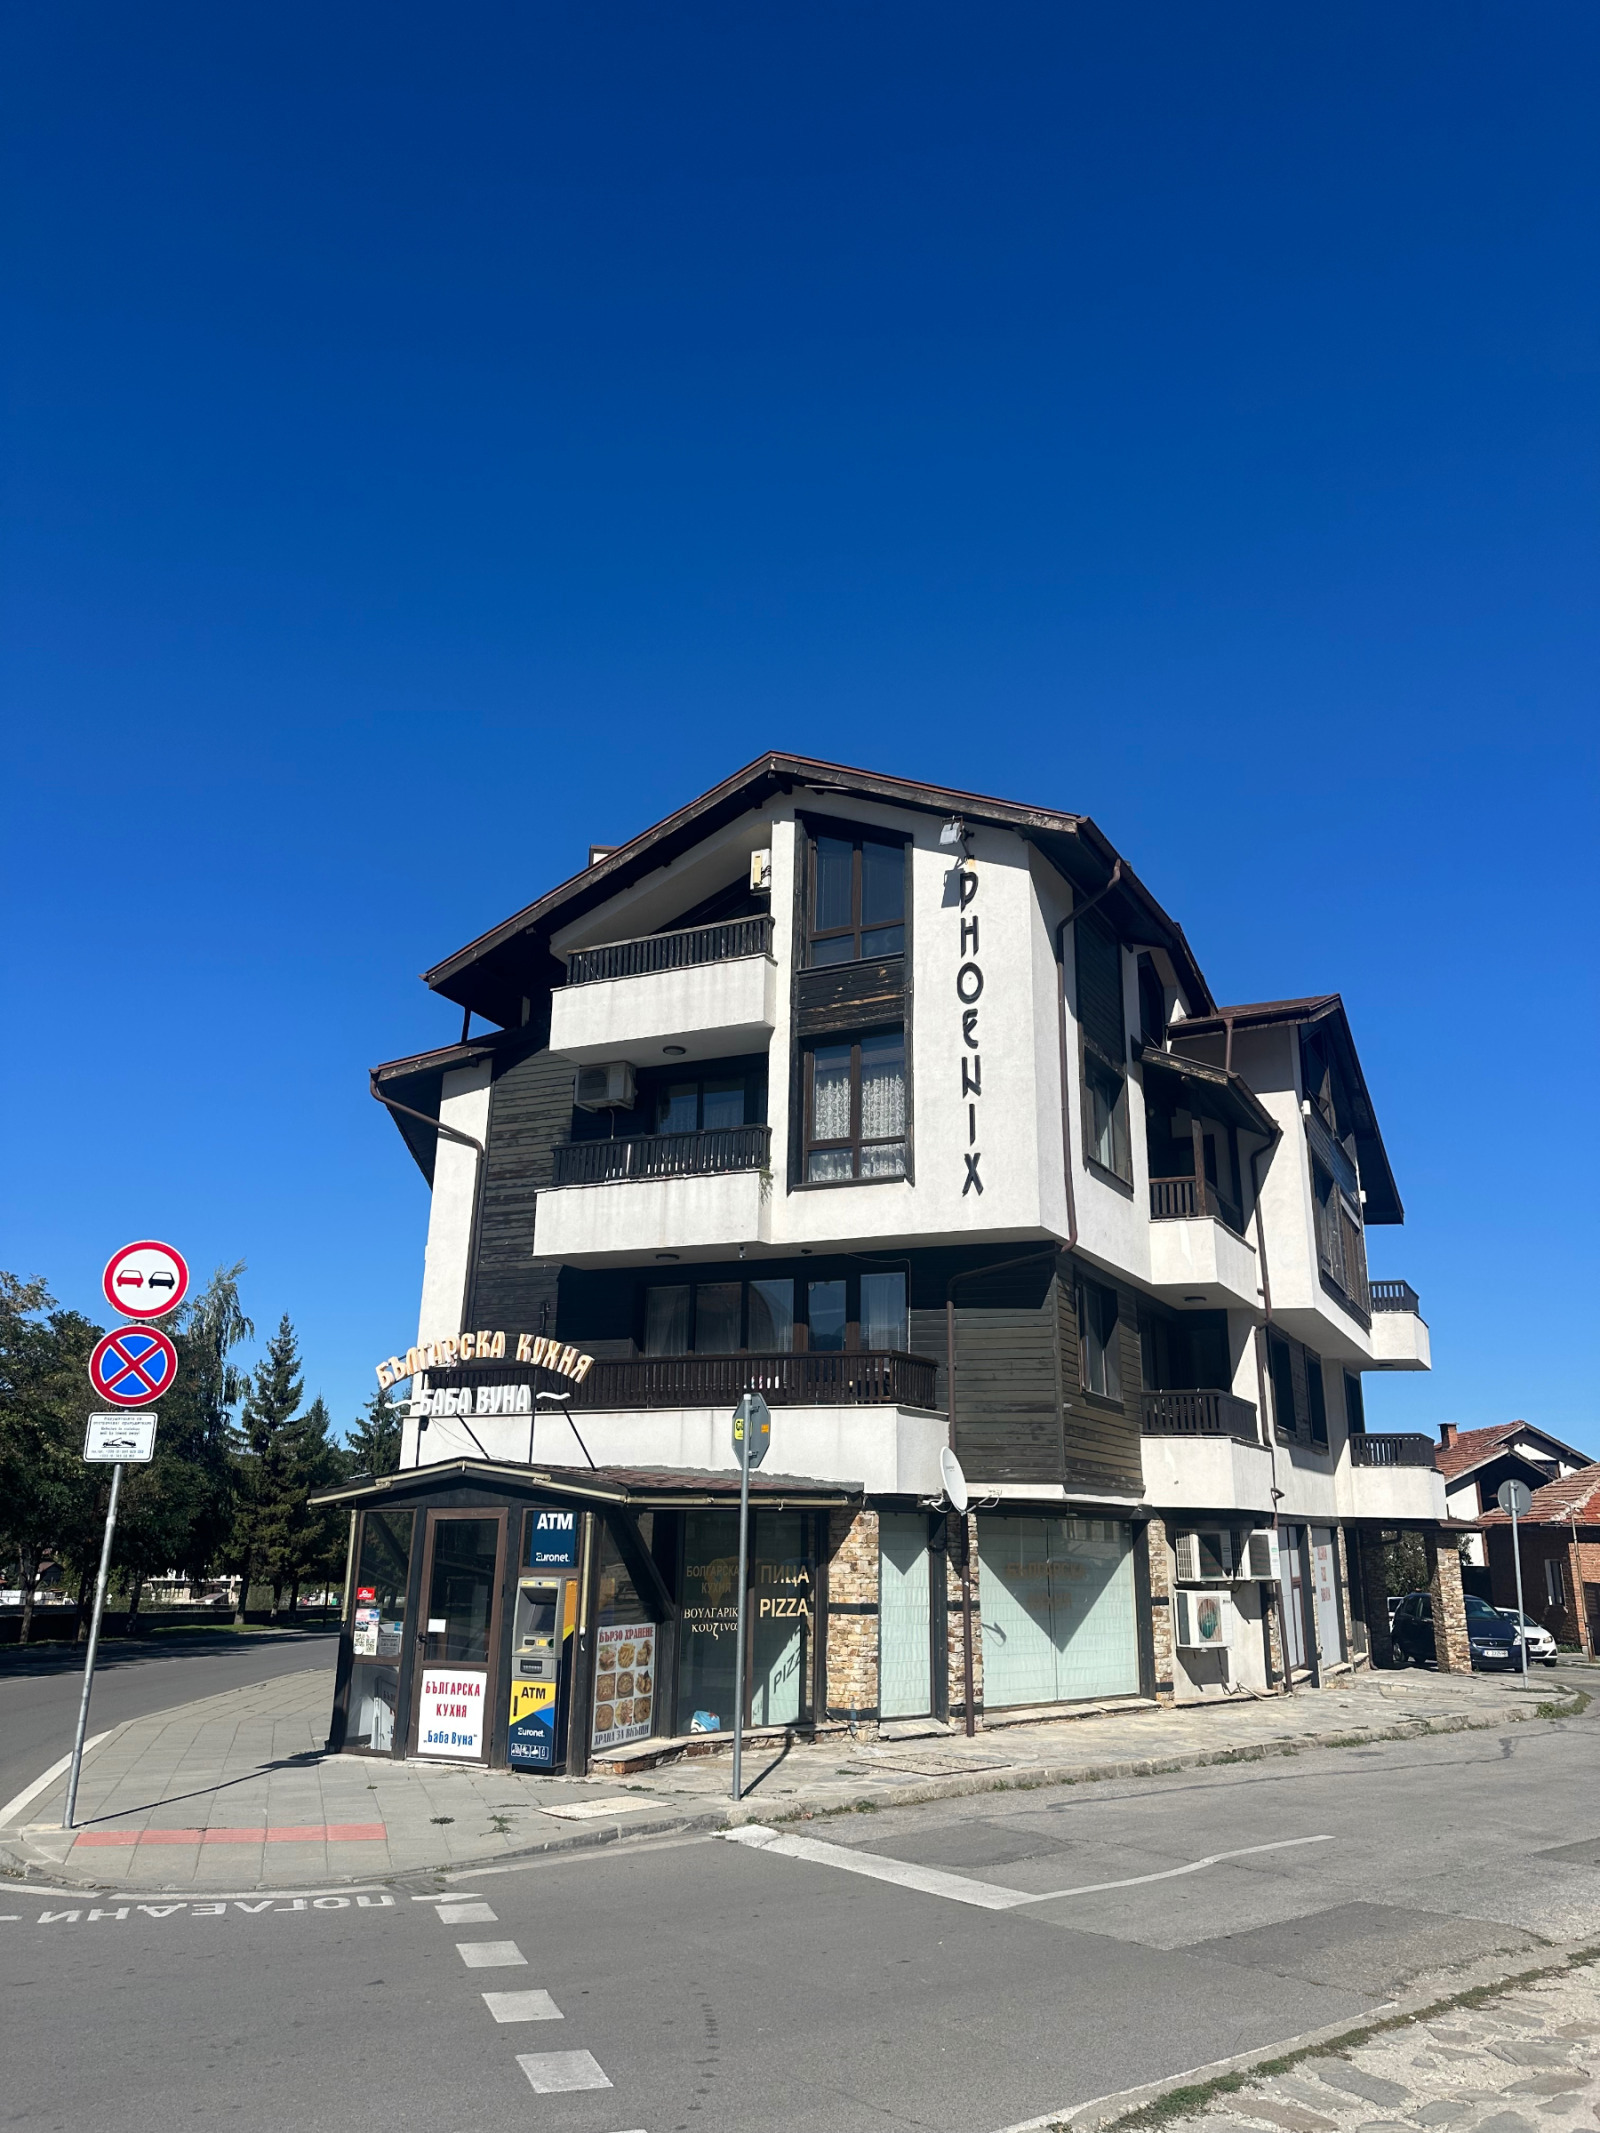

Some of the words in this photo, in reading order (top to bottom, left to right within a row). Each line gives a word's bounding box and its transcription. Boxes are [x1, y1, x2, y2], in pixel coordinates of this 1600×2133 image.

[957, 872, 984, 1197] PHOENIX
[375, 1330, 506, 1390] БЪЛГАРСКА
[516, 1333, 595, 1384] КУХНЯ
[420, 1387, 473, 1415] БАБА
[476, 1384, 532, 1413] ВУНА
[537, 1513, 574, 1530] ATM
[686, 1565, 740, 1577] БОЛГАРСКА
[761, 1564, 810, 1587] ПИЦА
[760, 1598, 809, 1618] PIZZA
[599, 1630, 623, 1643] БЪРЗО
[425, 1681, 480, 1697] БЪЛГАРСКА
[521, 1686, 546, 1699] ATM
[436, 1703, 467, 1718] КУХНЯ
[37, 1894, 396, 1925] ПОГЛЕДНИ
